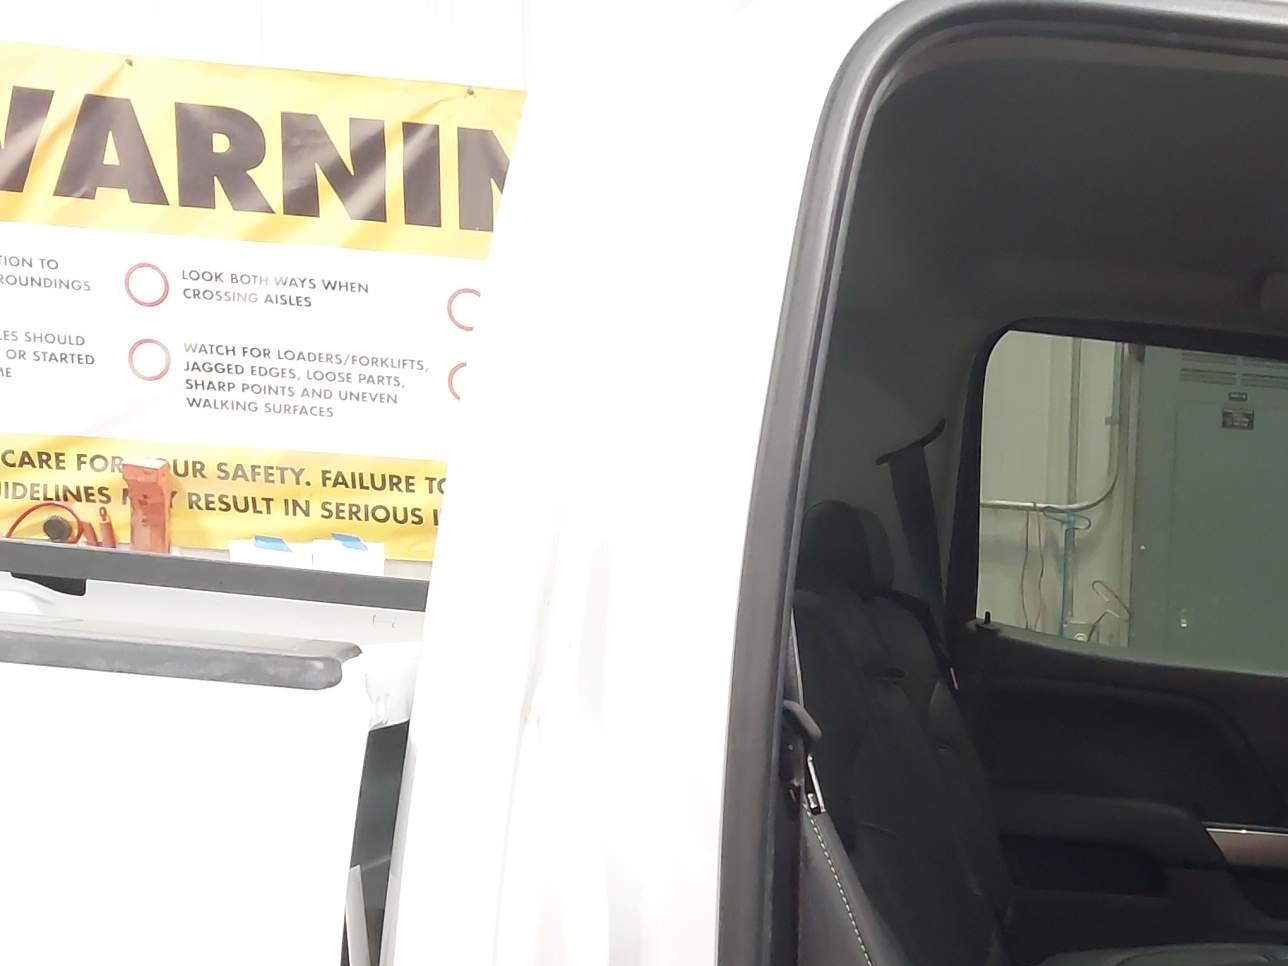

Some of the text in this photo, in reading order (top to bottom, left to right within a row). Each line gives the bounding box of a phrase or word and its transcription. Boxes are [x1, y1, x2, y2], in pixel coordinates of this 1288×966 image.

[40, 258, 59, 270] TO
[182, 269, 369, 294] LOOK BOTH WAYS WHEN
[183, 288, 312, 307] CROSSING AISLES
[24, 331, 85, 346] SHOULD
[6, 349, 95, 365] OR STARTED
[184, 343, 429, 372] WATCH FOR LOADERS/FORKLIFTS,
[184, 361, 406, 388] JAGGED EDGES, LOOSE PARTS,
[185, 379, 397, 404] SHARP POINTS AND UNEVEN
[186, 397, 334, 418] WALKING SURFACES
[0, 449, 66, 470] CARE
[76, 453, 124, 473] FOR
[216, 462, 312, 487] SAFETY.
[321, 470, 416, 493] FAILURE
[0, 481, 111, 505] IDELINES
[188, 492, 274, 515] RESULT
[284, 499, 310, 518] IN
[320, 501, 424, 526] SERIOUS
